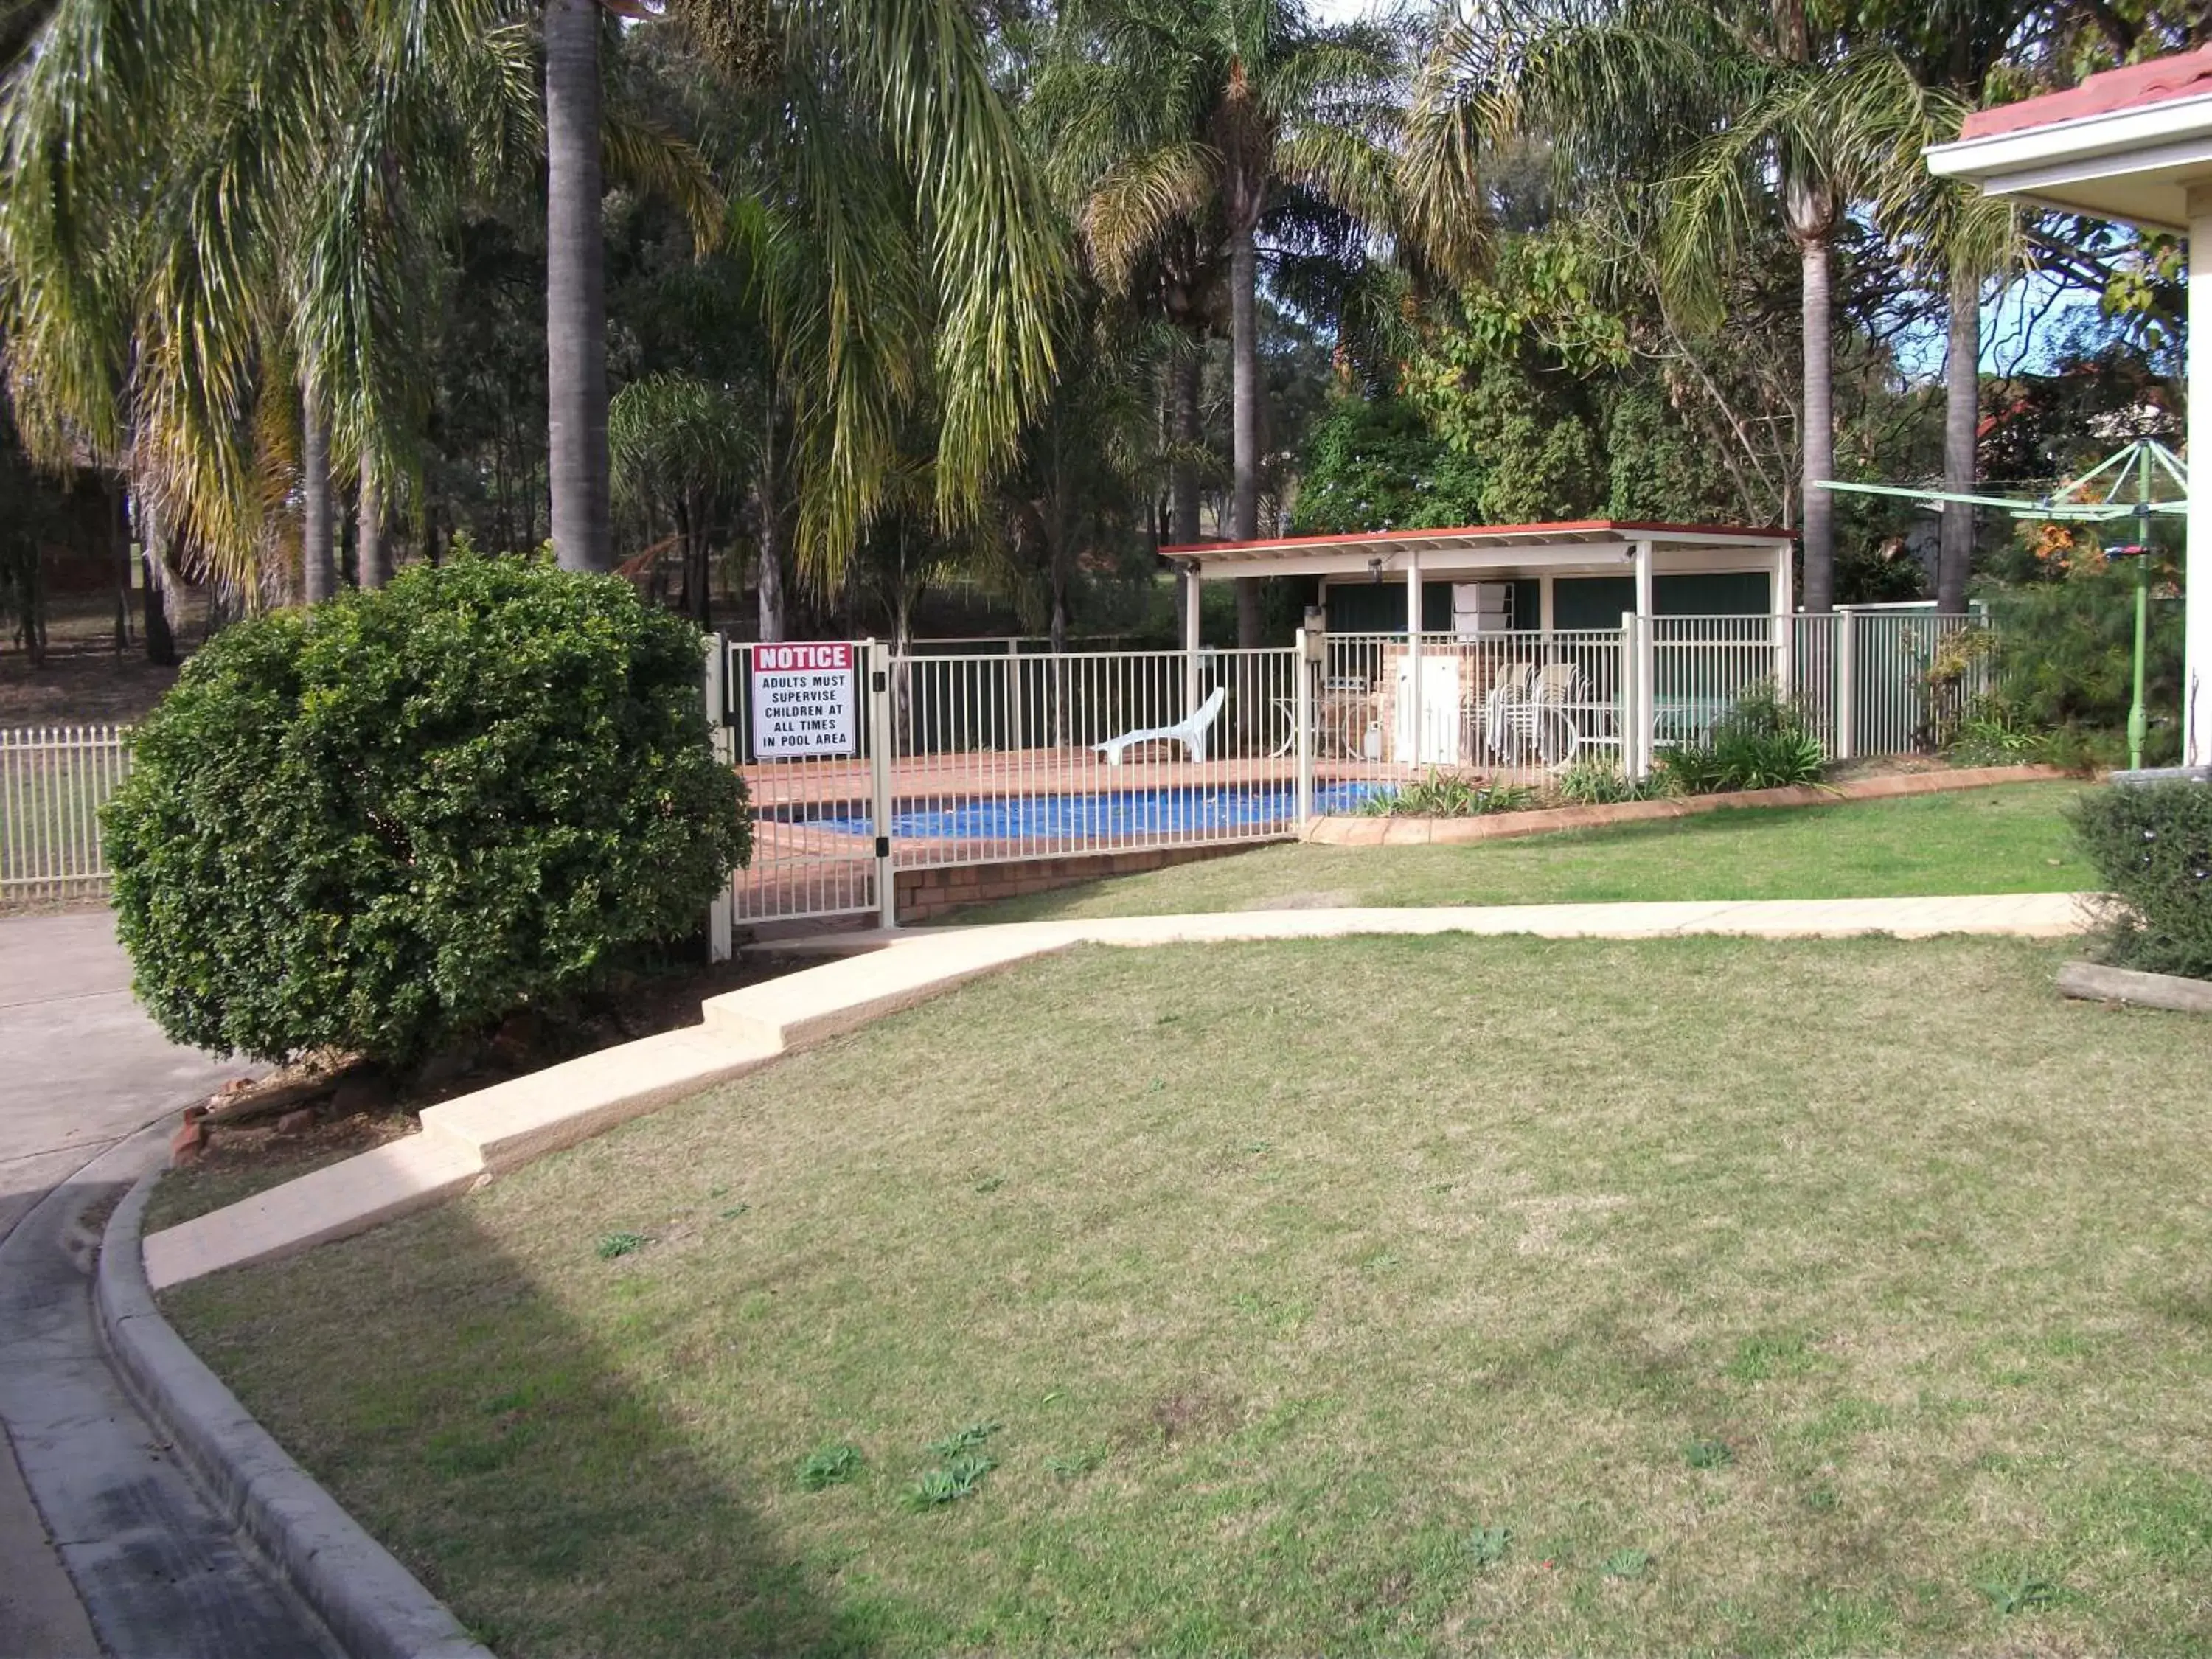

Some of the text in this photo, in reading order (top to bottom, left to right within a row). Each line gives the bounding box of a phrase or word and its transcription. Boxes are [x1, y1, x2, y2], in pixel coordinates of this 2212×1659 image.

[759, 646, 847, 669] NOTICE
[762, 675, 845, 688] ADULTS MUST
[772, 690, 837, 703] SUPERVISE
[765, 705, 843, 718] CHILDREN AT
[773, 720, 836, 732] ALL TIMES
[763, 734, 846, 748] IN POOL AREA
